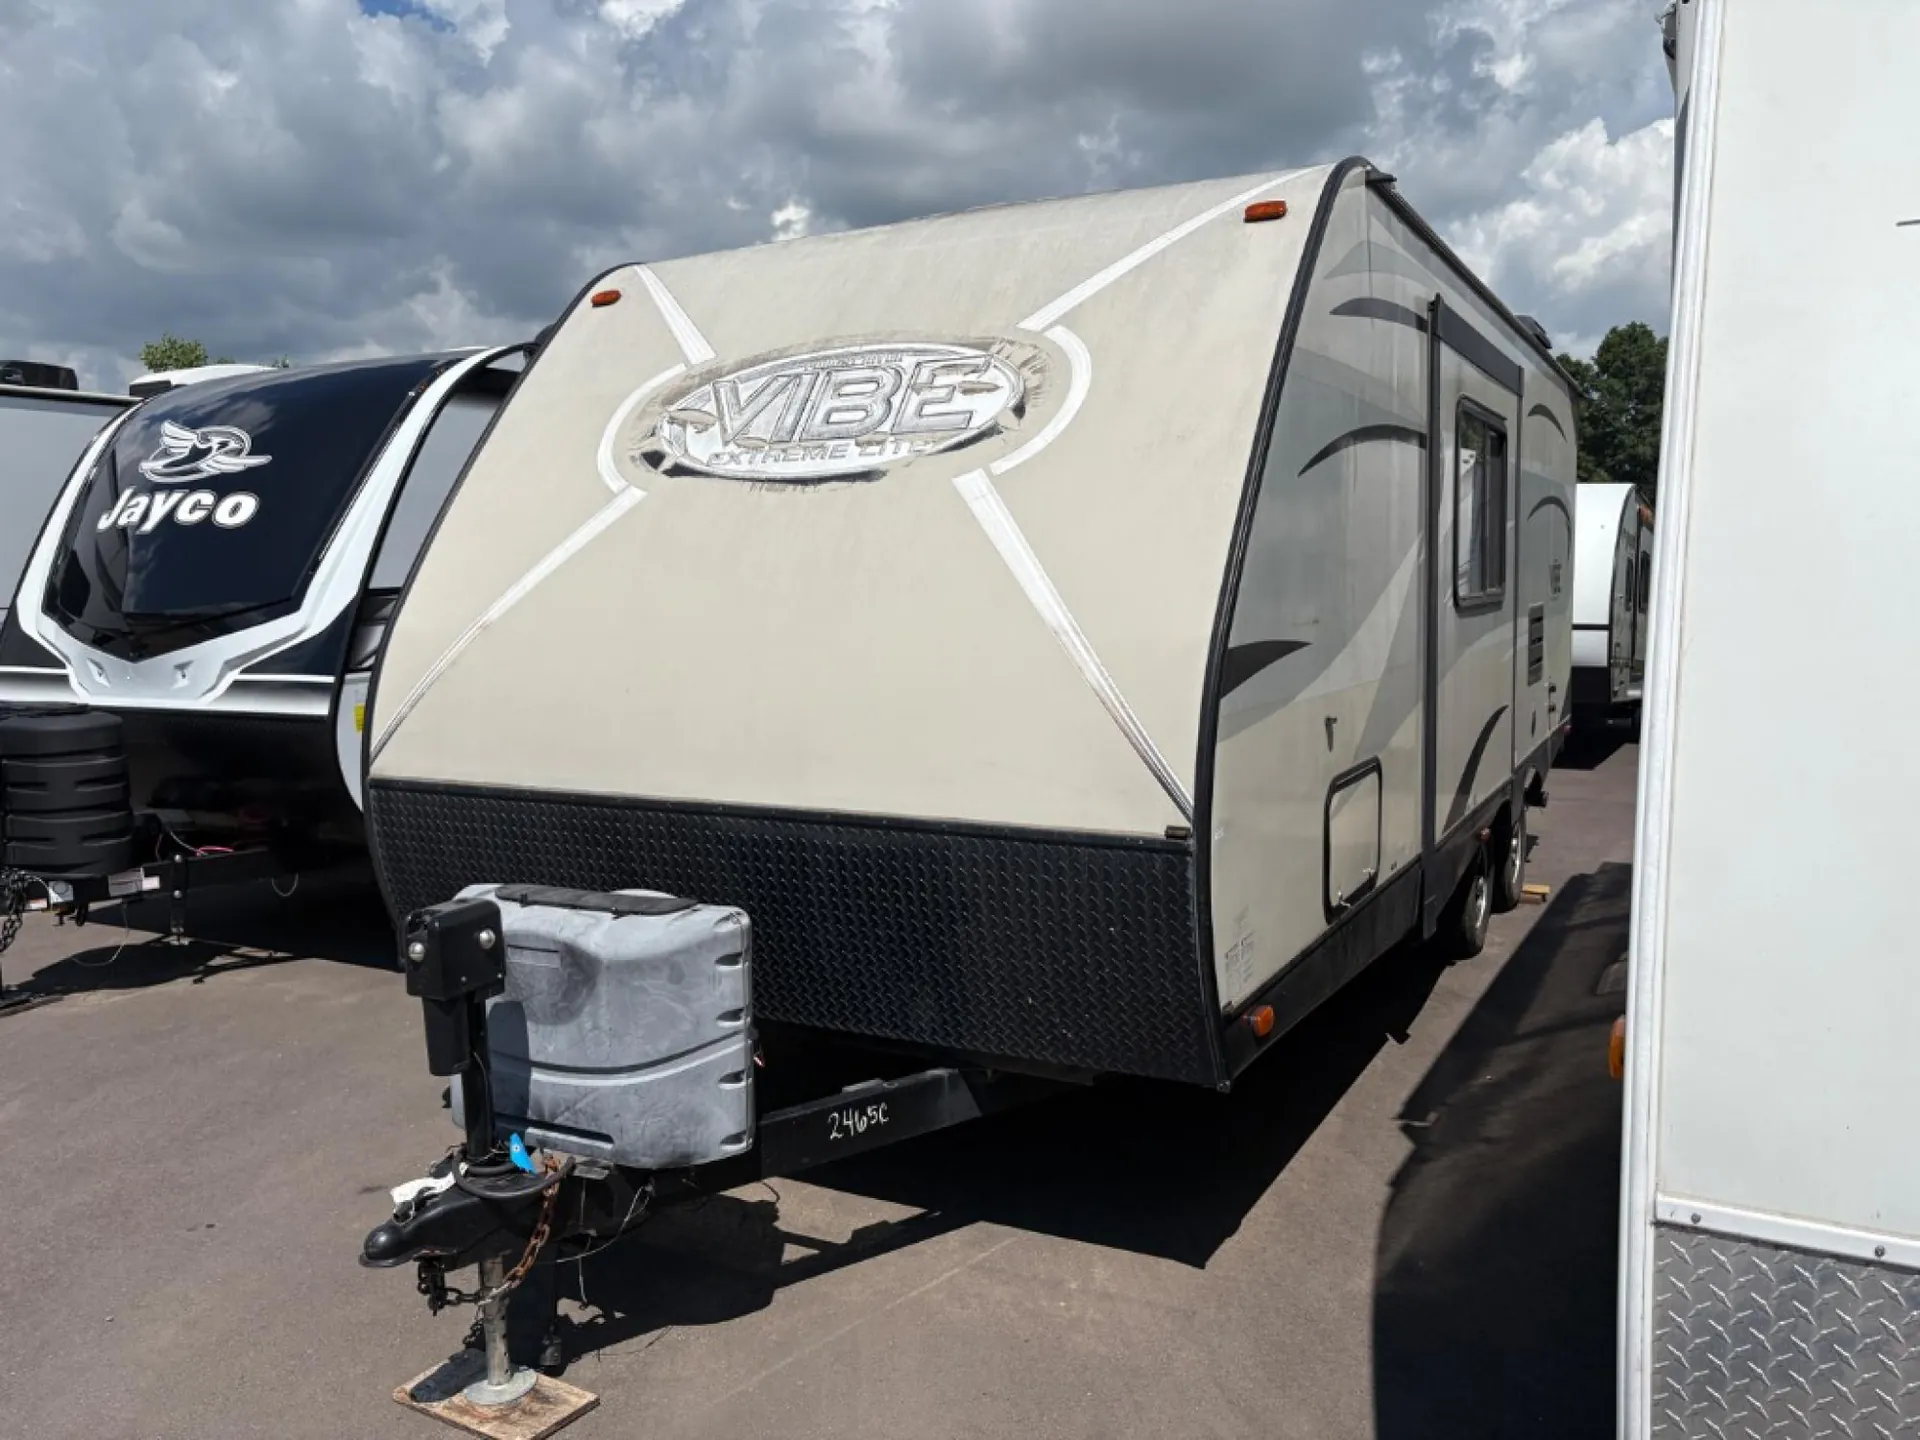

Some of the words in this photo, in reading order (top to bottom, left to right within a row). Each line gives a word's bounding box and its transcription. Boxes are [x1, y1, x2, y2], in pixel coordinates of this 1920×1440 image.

[711, 354, 993, 447] VIBE
[706, 443, 849, 467] EXTREME
[97, 485, 259, 535] Jayco
